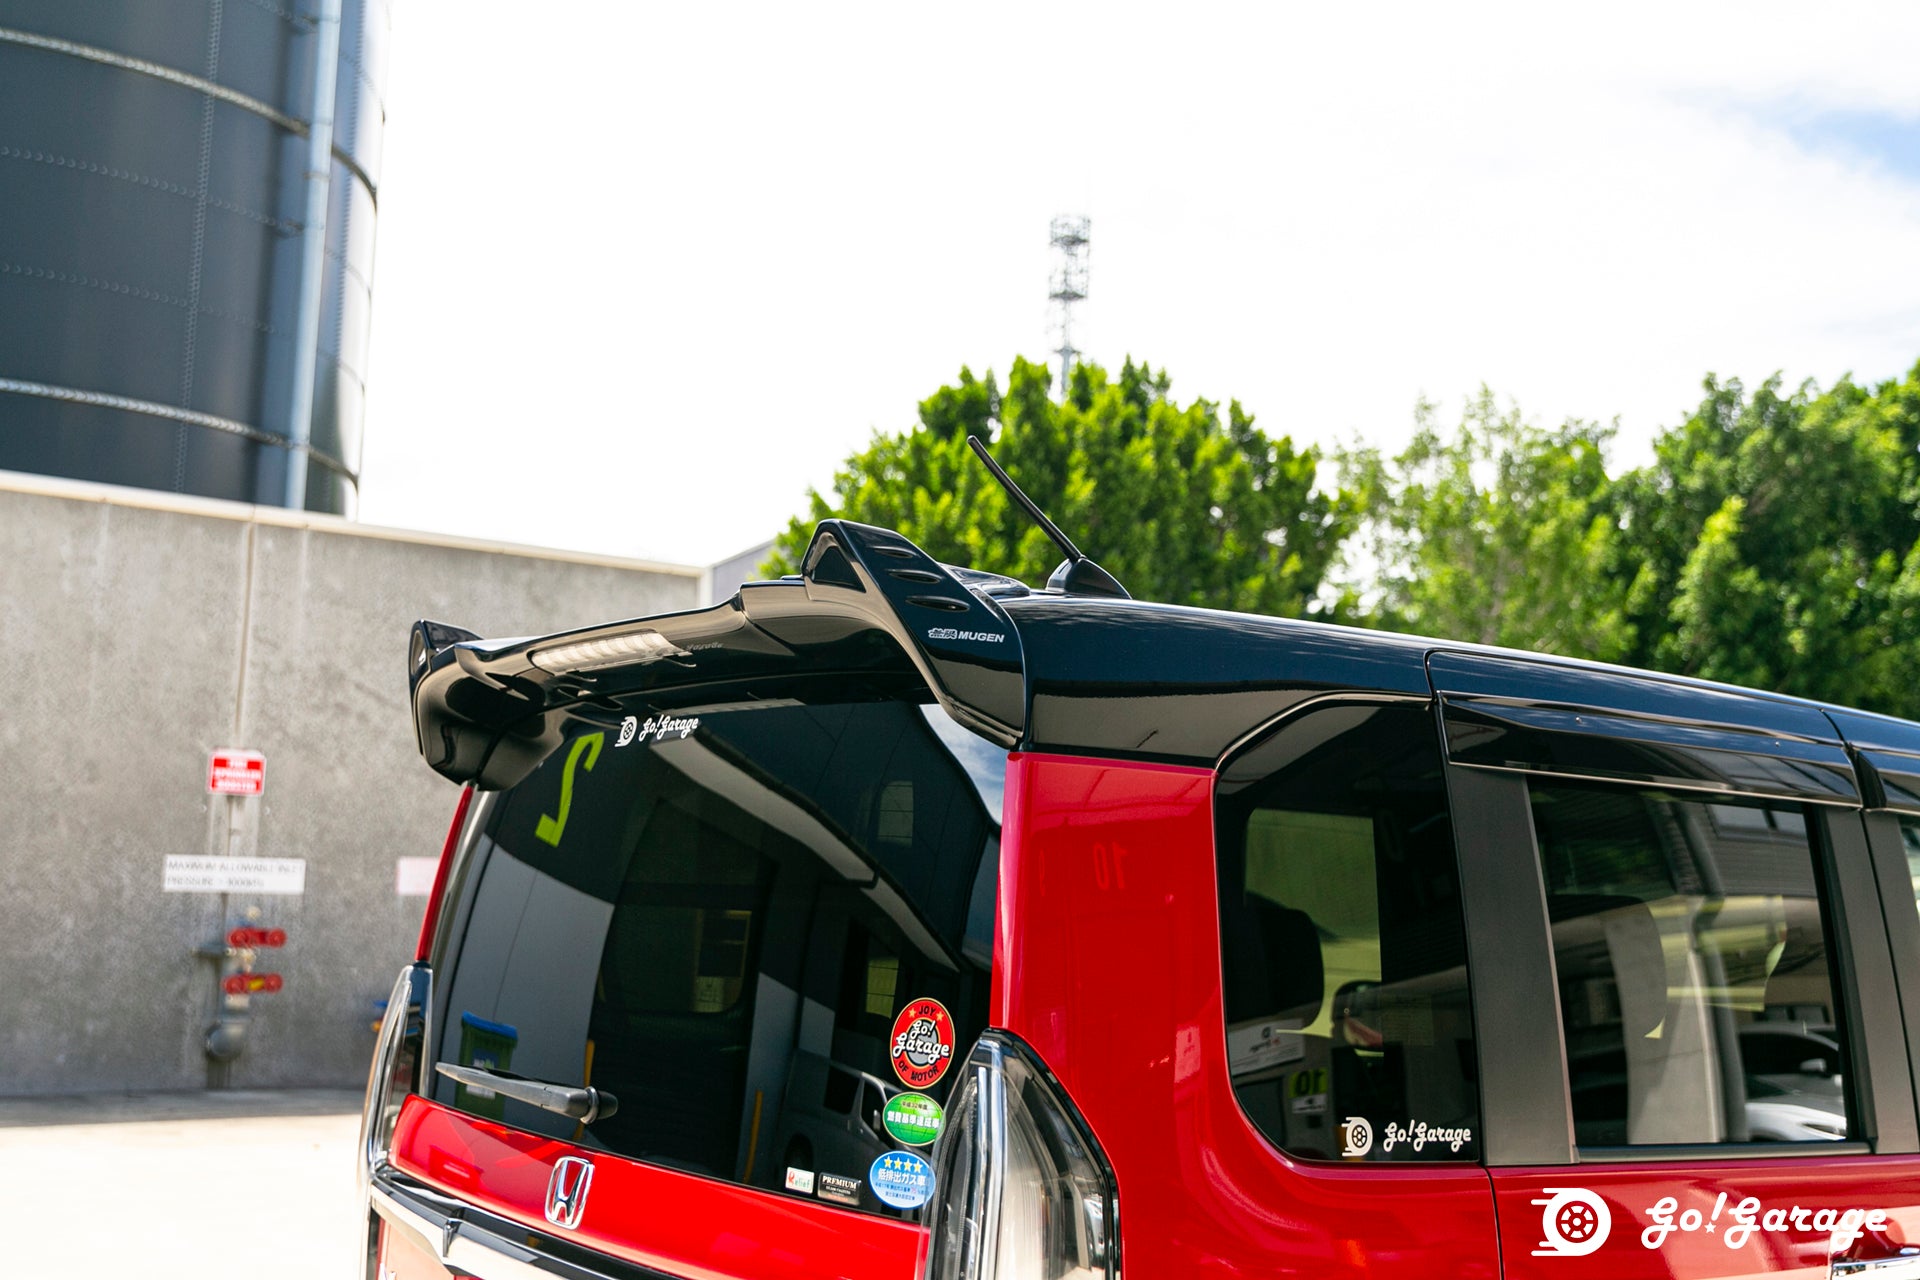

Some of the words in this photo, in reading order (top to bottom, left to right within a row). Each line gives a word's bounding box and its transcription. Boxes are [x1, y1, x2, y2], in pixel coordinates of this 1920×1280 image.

[958, 631, 1005, 642] MUGEN
[918, 1005, 936, 1017] JOY
[910, 1019, 936, 1040] Go!
[893, 1032, 949, 1064] Garage
[898, 1060, 909, 1073] OF
[910, 1065, 940, 1083] MOTOR
[822, 1175, 857, 1190] PREMIUM
